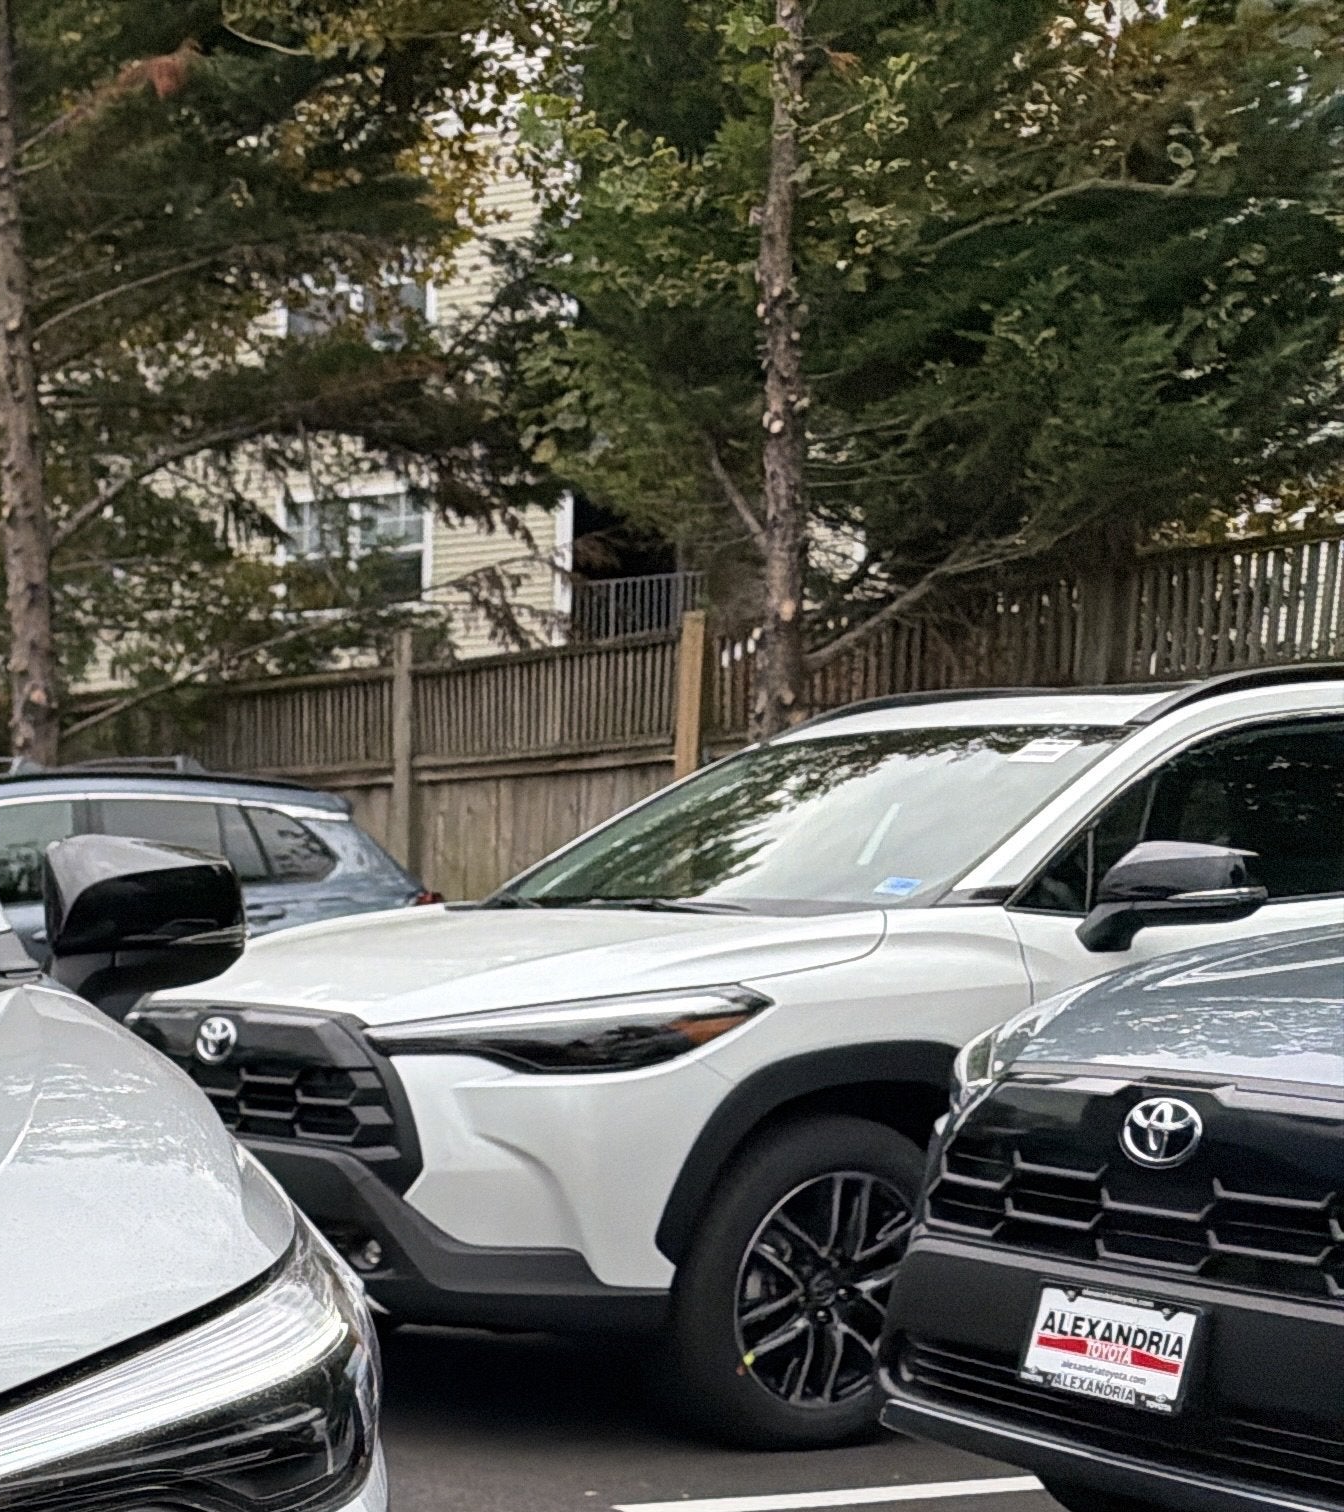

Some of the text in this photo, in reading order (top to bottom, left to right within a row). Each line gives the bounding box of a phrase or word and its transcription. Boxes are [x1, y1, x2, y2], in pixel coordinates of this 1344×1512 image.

[1040, 1311, 1184, 1359] ALEXANDRIA
[1087, 1342, 1132, 1363] TOYOTA
[1052, 1373, 1136, 1403] ALEXANDRIA
